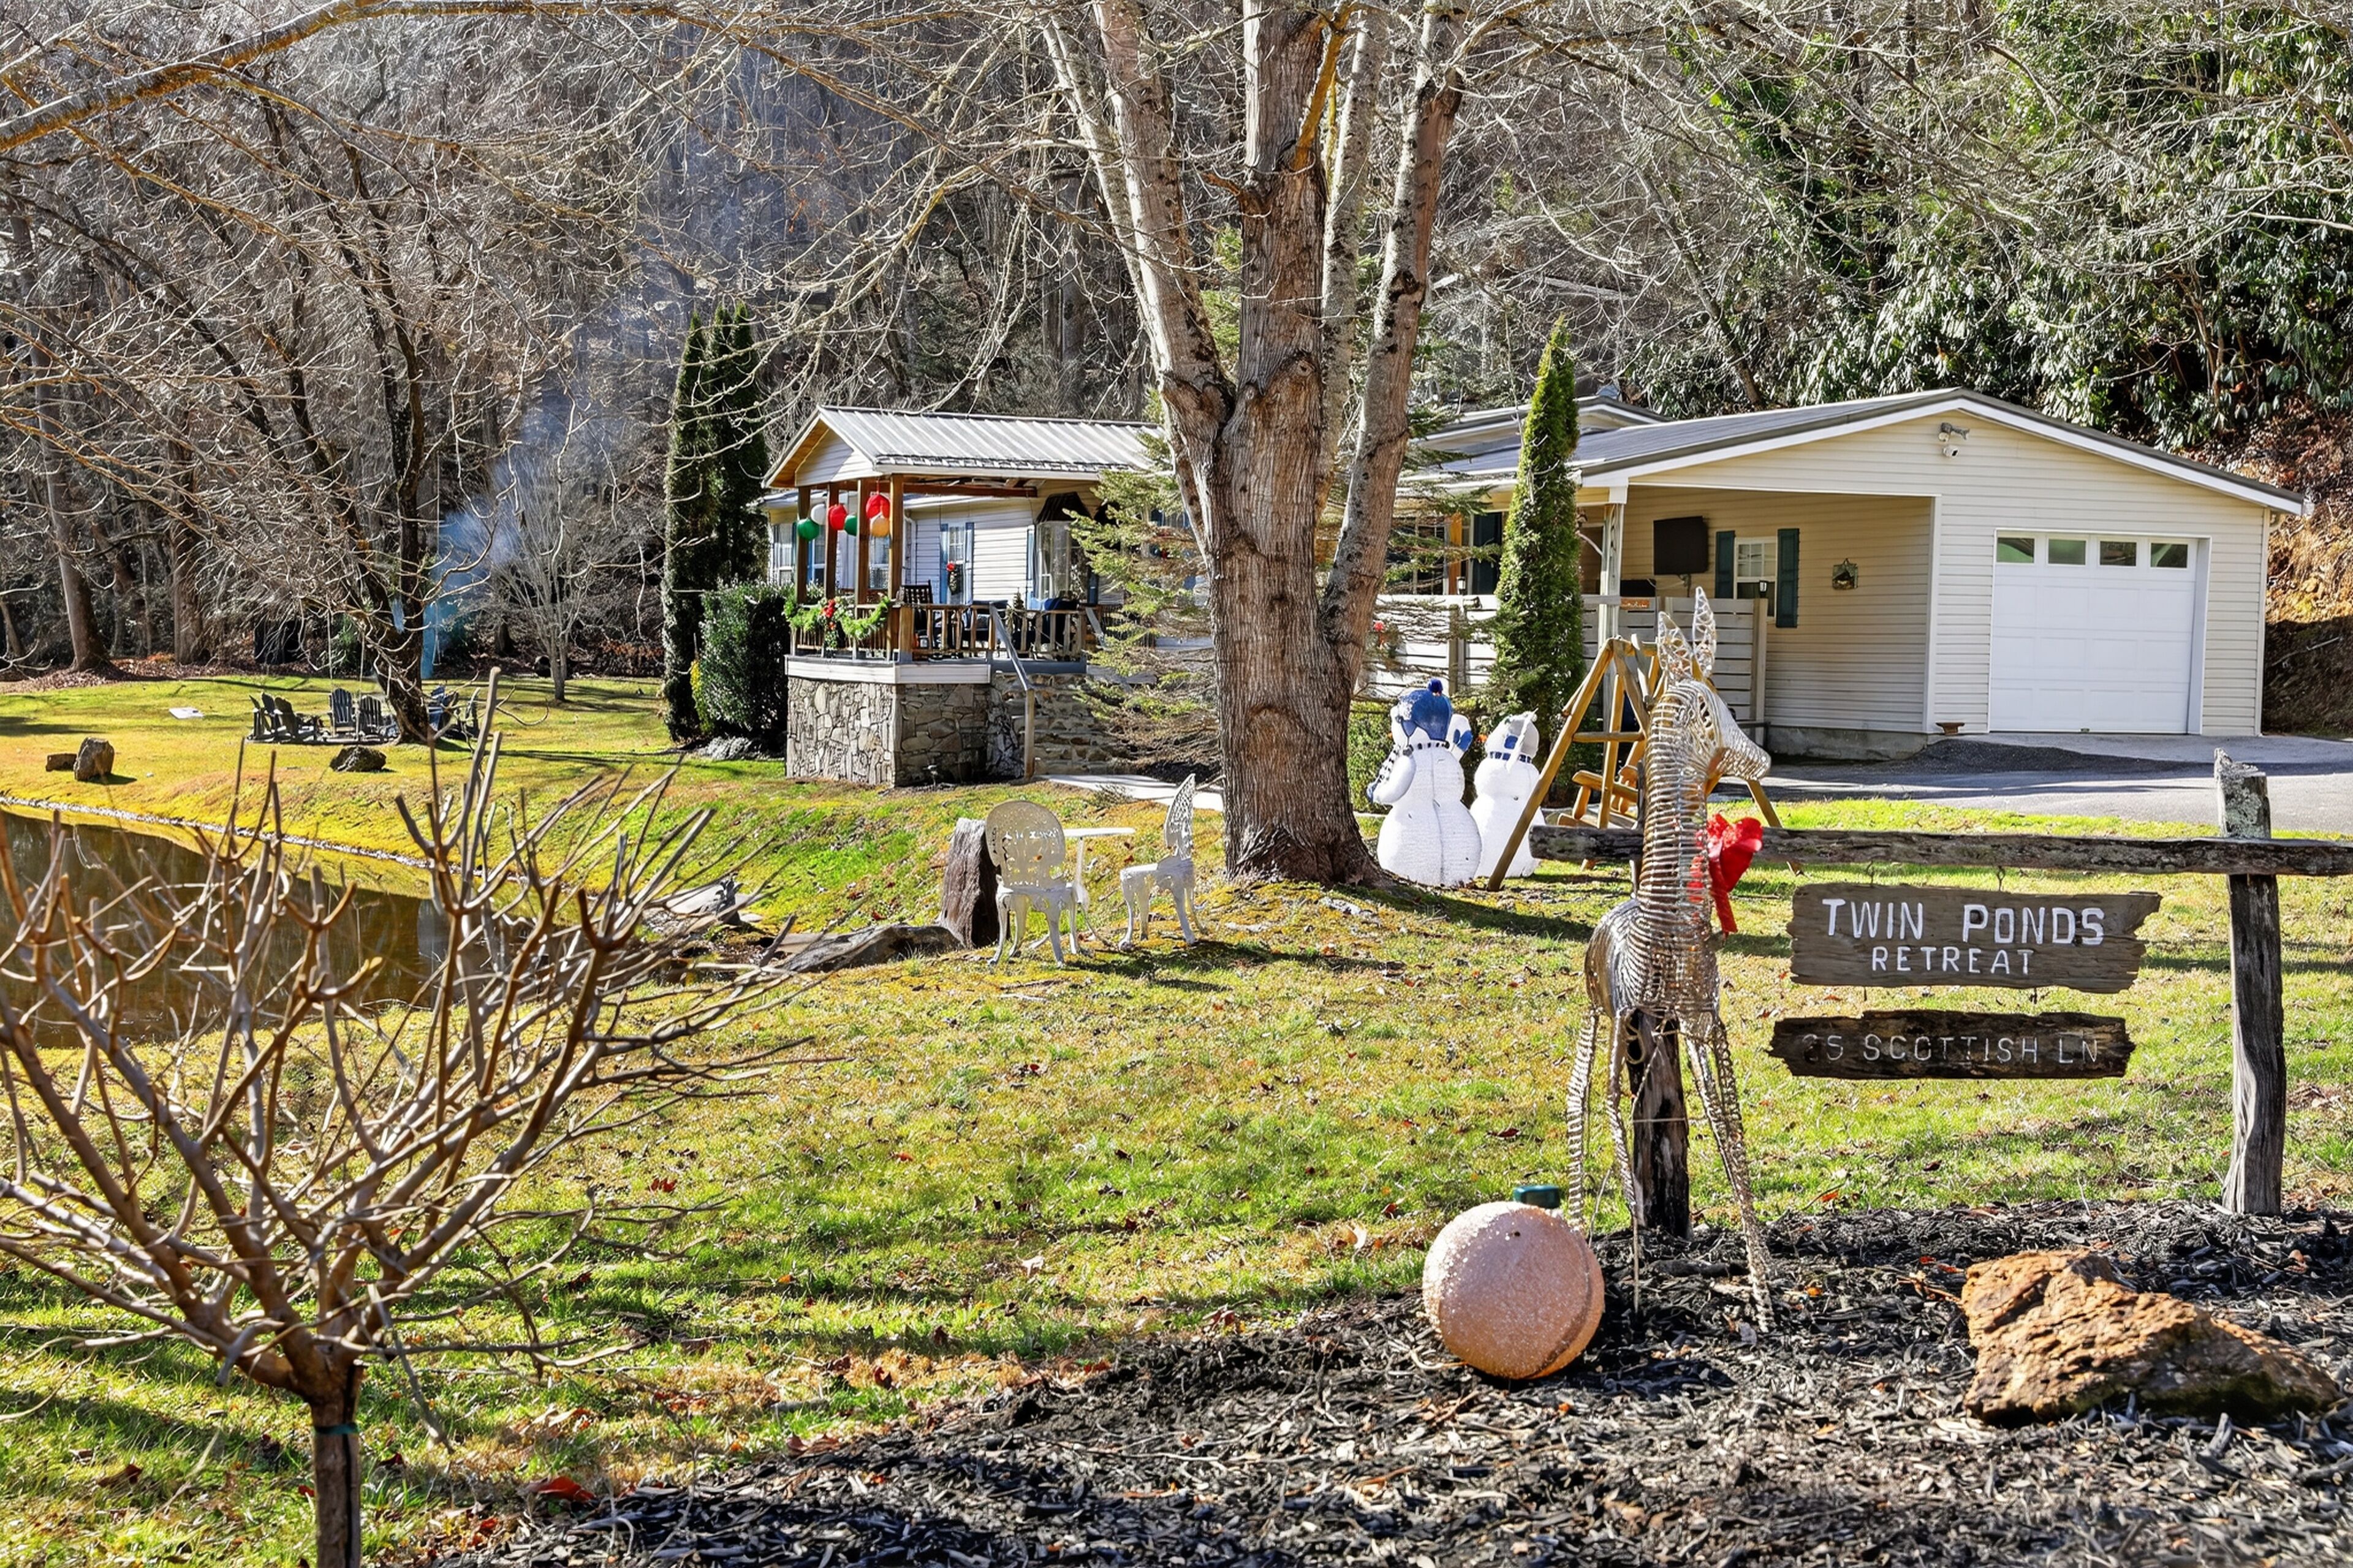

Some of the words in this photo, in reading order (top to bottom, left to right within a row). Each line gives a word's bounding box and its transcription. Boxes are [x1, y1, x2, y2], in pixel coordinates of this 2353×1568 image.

[1822, 898, 1923, 940] TWIN
[1962, 904, 2105, 945] PONDS
[1871, 946, 2034, 975] RETREAT
[1863, 1033, 2037, 1064] SCOTTISH
[2059, 1038, 2097, 1064] LN
